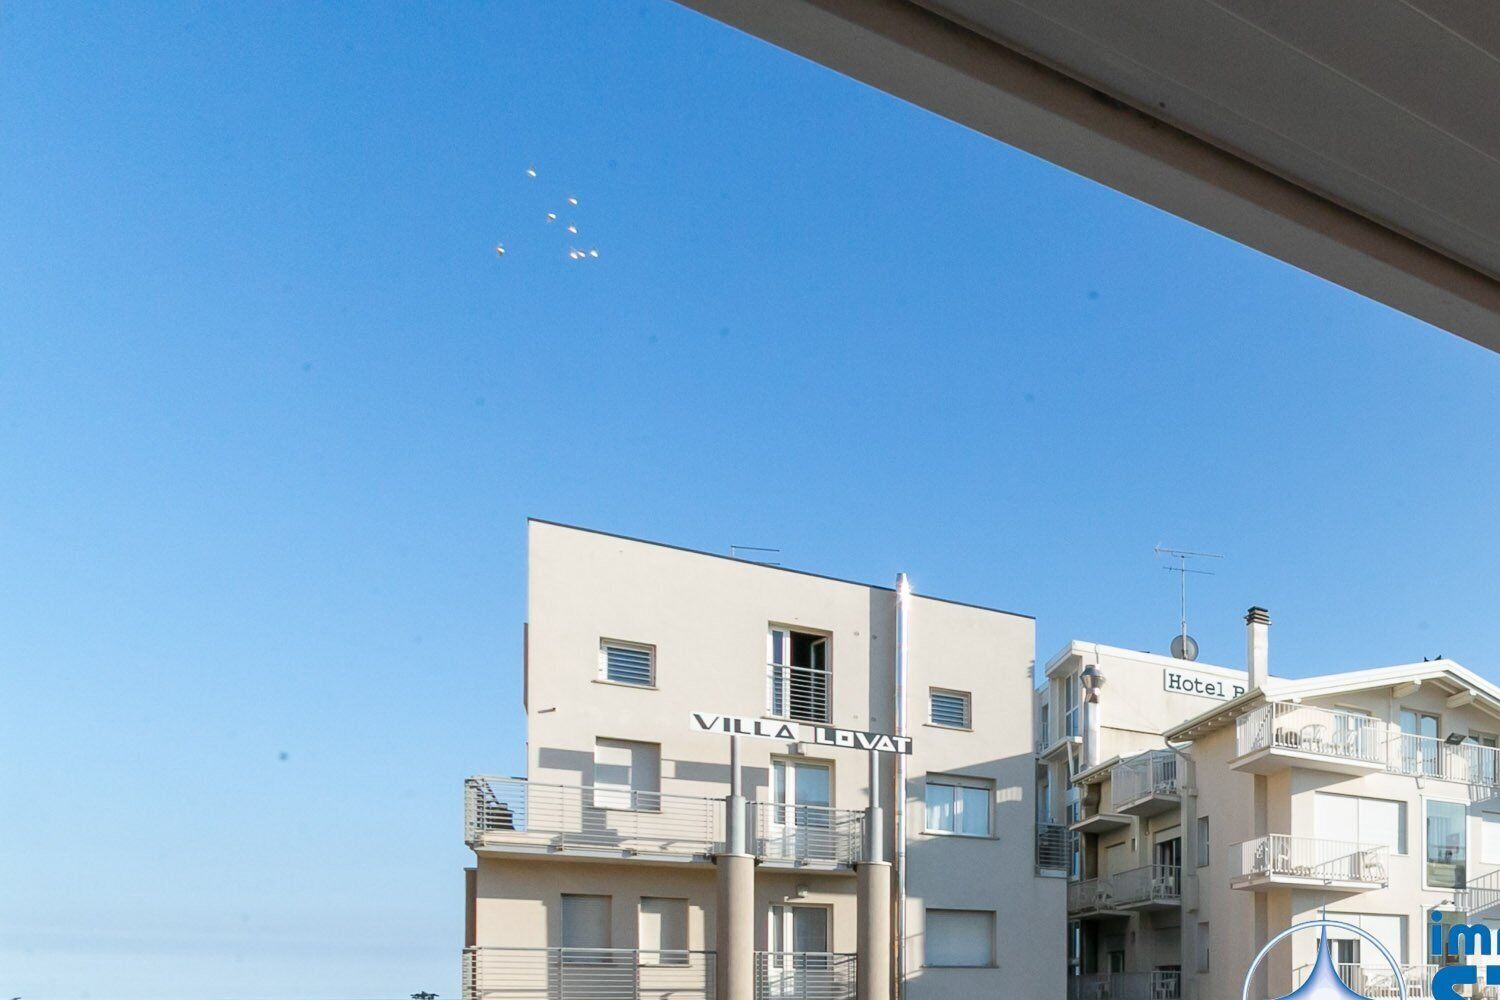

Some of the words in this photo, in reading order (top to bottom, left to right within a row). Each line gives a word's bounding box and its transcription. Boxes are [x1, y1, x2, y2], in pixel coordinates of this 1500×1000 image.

[1168, 673, 1225, 697] Hotel
[693, 713, 795, 740] VILLA
[816, 727, 911, 753] LOVAT
